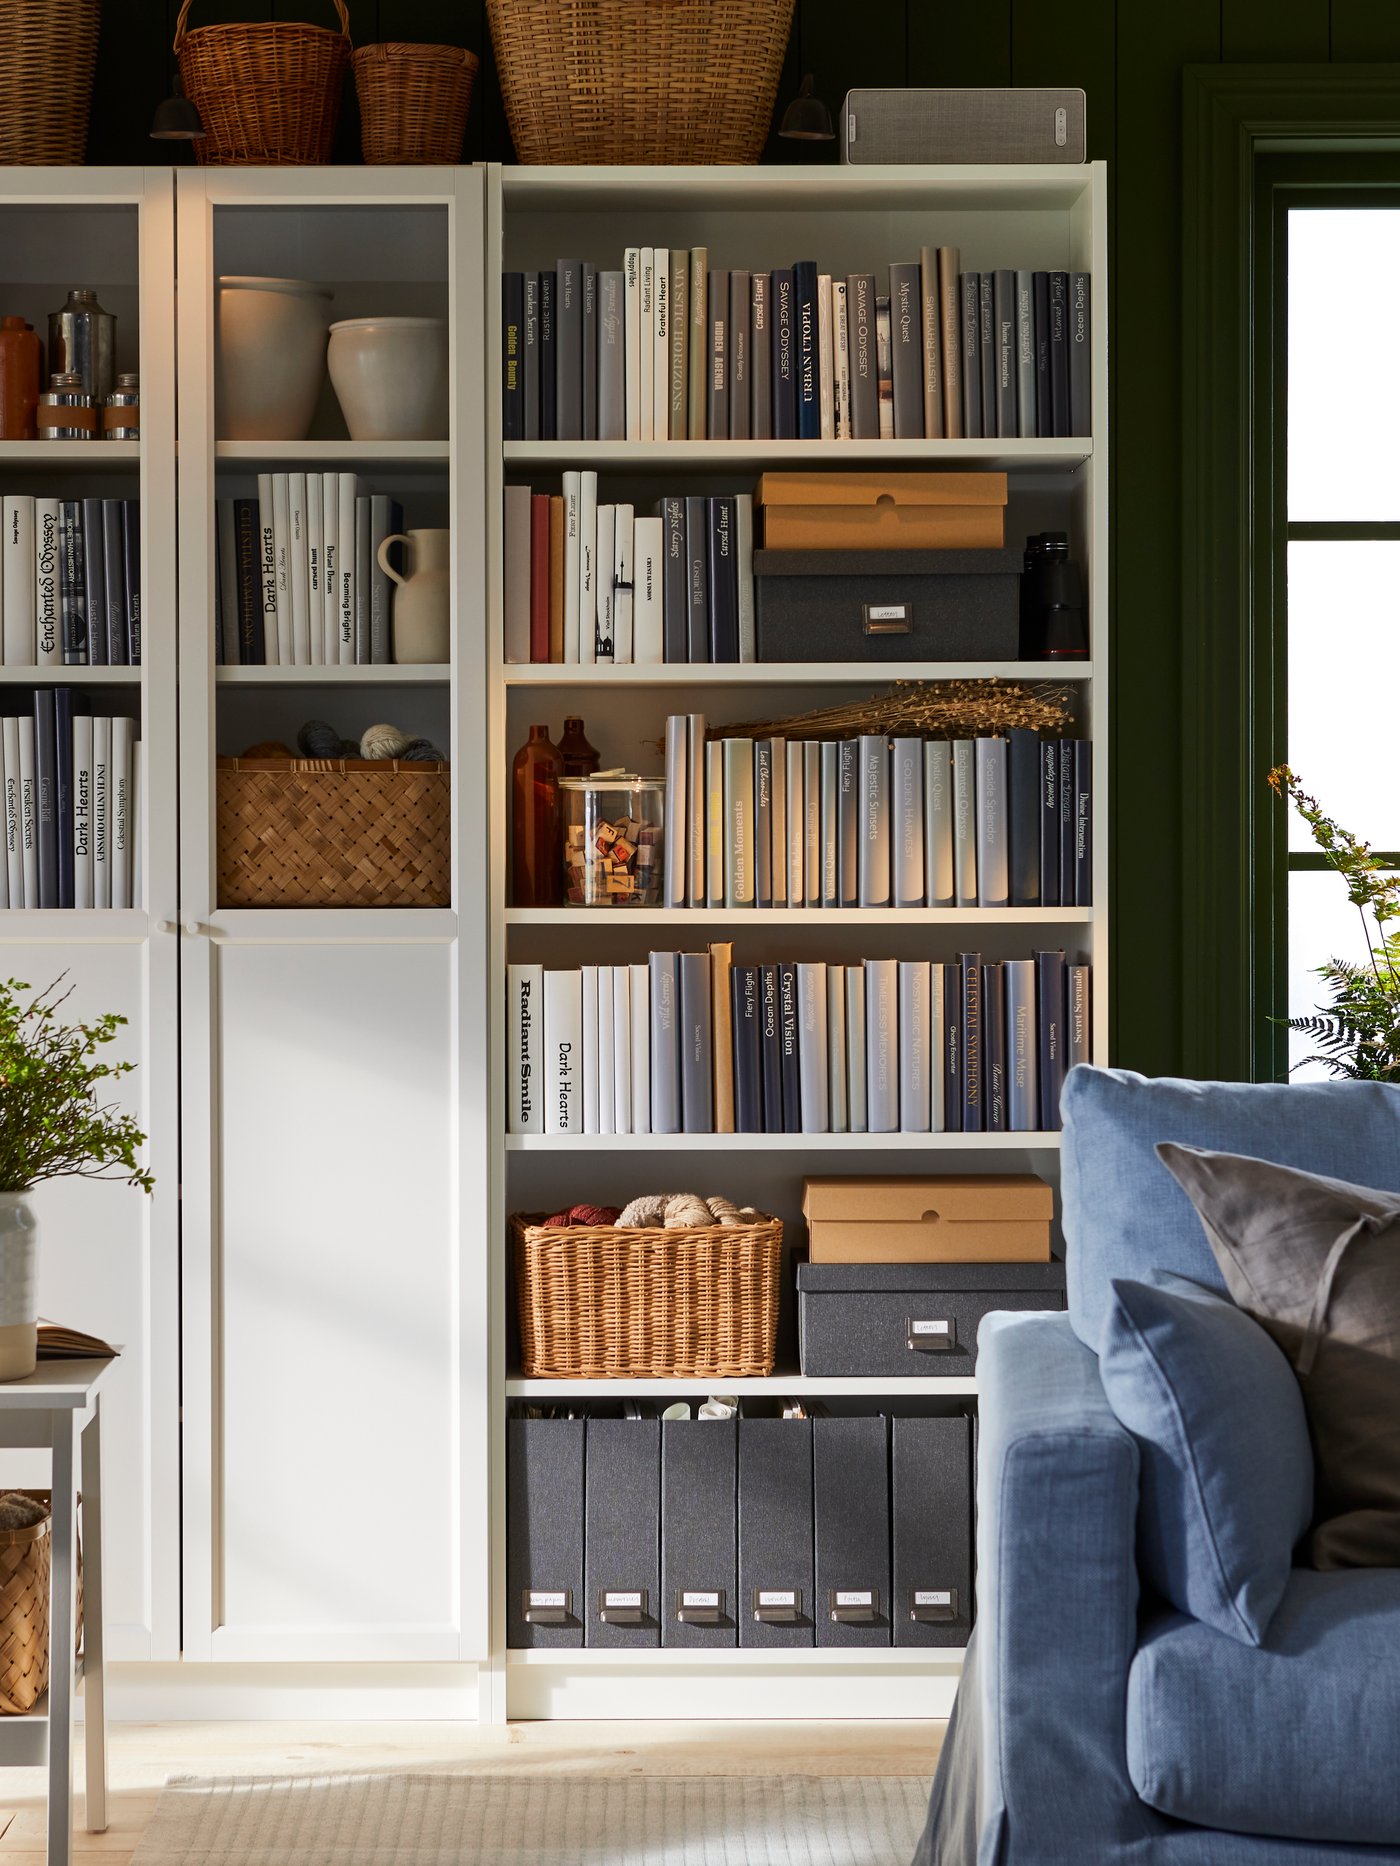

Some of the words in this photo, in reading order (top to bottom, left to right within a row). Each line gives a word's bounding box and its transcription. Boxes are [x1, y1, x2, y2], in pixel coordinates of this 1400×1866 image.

[564, 270, 572, 287] Dark
[644, 266, 652, 286] Living
[659, 276, 667, 301] Heart
[694, 260, 704, 287] Sunsets
[755, 279, 764, 301] Hunt
[527, 280, 537, 315] Forsaken
[564, 288, 572, 309] Hearts
[674, 268, 685, 327] MYSTIC
[695, 288, 705, 326] Mysterious
[779, 282, 789, 326] SAVAGE
[857, 280, 867, 324] SAVAGE
[900, 281, 910, 314] Mystic
[967, 281, 976, 316] Distant
[981, 279, 992, 308] Jungle
[1021, 290, 1029, 319] Visions
[1053, 277, 1064, 307] Jungle
[1075, 277, 1086, 309] Depths
[527, 317, 537, 345] Secrets
[659, 302, 667, 337] Grateful
[753, 301, 764, 330] Cursed
[802, 302, 812, 353] UTOPIA
[900, 315, 910, 343] Quest
[926, 295, 935, 349] RHYTHMS
[982, 308, 991, 344] Untamed
[1001, 321, 1011, 344] Divine
[1053, 306, 1062, 342] Untamed
[1075, 311, 1085, 342] Ocean
[507, 325, 518, 355] Golden
[714, 320, 724, 352] HIDDEN
[859, 326, 868, 379] ODYSSEY
[967, 318, 976, 357] Dreams
[1021, 321, 1034, 364] Mysterious
[673, 331, 684, 412] HORIZONS
[736, 359, 744, 381] Ghostly
[780, 328, 790, 381] ODYSSEY
[1001, 345, 1011, 388] Intervention
[507, 360, 518, 391] Bounty
[714, 356, 724, 391] AGENDA
[803, 356, 813, 402] URBAN
[927, 352, 937, 393] RUSTIC
[667, 501, 683, 529] Nights
[720, 505, 729, 528] Hunt
[39, 513, 57, 574] Odyssey
[240, 507, 252, 568] CELESTIAL
[262, 527, 273, 574] Hearts
[670, 529, 683, 558] Starry
[717, 529, 729, 556] Cursed
[278, 547, 286, 571] Hearts
[326, 545, 335, 568] Distant
[279, 571, 287, 591] Dark
[326, 570, 335, 595] Dreams
[342, 572, 351, 609] Beaming
[693, 559, 703, 591] Cosmic
[131, 593, 139, 622] Secrets
[243, 575, 254, 647] SYMPHONY
[264, 579, 276, 613] Dark
[693, 591, 703, 605] Rift
[39, 577, 56, 654] Enchanted
[90, 599, 98, 628] Rustic
[111, 601, 120, 631] Rustic
[341, 610, 352, 643] Brightly
[112, 633, 121, 662] Haven
[759, 750, 768, 766] Lost
[842, 747, 852, 770] Flight
[932, 751, 942, 782] Mystic
[959, 750, 968, 797] Enchanted
[1045, 745, 1055, 781] Expedition
[1063, 746, 1071, 782] Distant
[41, 777, 51, 808] Cosmic
[76, 770, 88, 817] Hearts
[96, 763, 105, 821] ENCHANTED
[759, 767, 769, 807] Chronicles
[842, 772, 851, 792] Fiery
[869, 755, 879, 799] Majestic
[903, 758, 913, 806] GOLDEN
[985, 758, 995, 797] Seaside
[7, 778, 17, 818] Enchanted
[24, 779, 32, 817] Forsaken
[117, 777, 127, 817] Symphony
[933, 783, 943, 811] Quest
[1046, 781, 1055, 809] Ancient
[1063, 784, 1072, 822] Dreams
[1079, 792, 1089, 816] Divine
[41, 808, 51, 823] Rift
[734, 800, 744, 855] Moments
[869, 801, 879, 840] Sunsets
[958, 800, 968, 840] Odyssey
[985, 800, 996, 844] Splendor
[8, 820, 17, 852] Odyssey
[25, 819, 33, 850] Secrets
[76, 822, 88, 856] Dark
[96, 822, 105, 864] ODYSSEY
[116, 818, 125, 850] Celestial
[903, 809, 913, 860] HARVEST
[1078, 817, 1088, 859] Intervention
[824, 841, 835, 869] Quest
[735, 857, 745, 900] Golden
[824, 870, 834, 900] Mystic
[659, 971, 673, 1005] Serenity
[745, 972, 755, 996] Flight
[765, 971, 775, 1003] Depths
[782, 972, 794, 1015] Crystal
[805, 970, 815, 1003] Horizons
[967, 967, 977, 1029] CELESTIAL
[1073, 970, 1083, 1013] Serenade
[659, 1006, 671, 1030] Wild
[745, 998, 754, 1018] Fiery
[806, 1003, 816, 1032] Majestic
[878, 976, 888, 1029] TIMELESS
[912, 972, 921, 1035] NOSTALGIC
[521, 980, 531, 1062] Radiant
[765, 1006, 774, 1037] Ocean
[784, 1018, 794, 1056] Vision
[949, 1026, 957, 1047] Ghostly
[1016, 1005, 1027, 1055] Maritime
[1073, 1013, 1082, 1044] Secret
[559, 1042, 572, 1076] Dark
[878, 1031, 888, 1090] MEMORIES
[911, 1038, 921, 1090] NATURES
[967, 1034, 978, 1107] SYMPHONY
[1016, 1058, 1026, 1088] Muse
[521, 1063, 531, 1123] Smile
[992, 1063, 1001, 1092] Rustic
[559, 1081, 572, 1128] Hearts
[992, 1094, 1003, 1124] Haven
